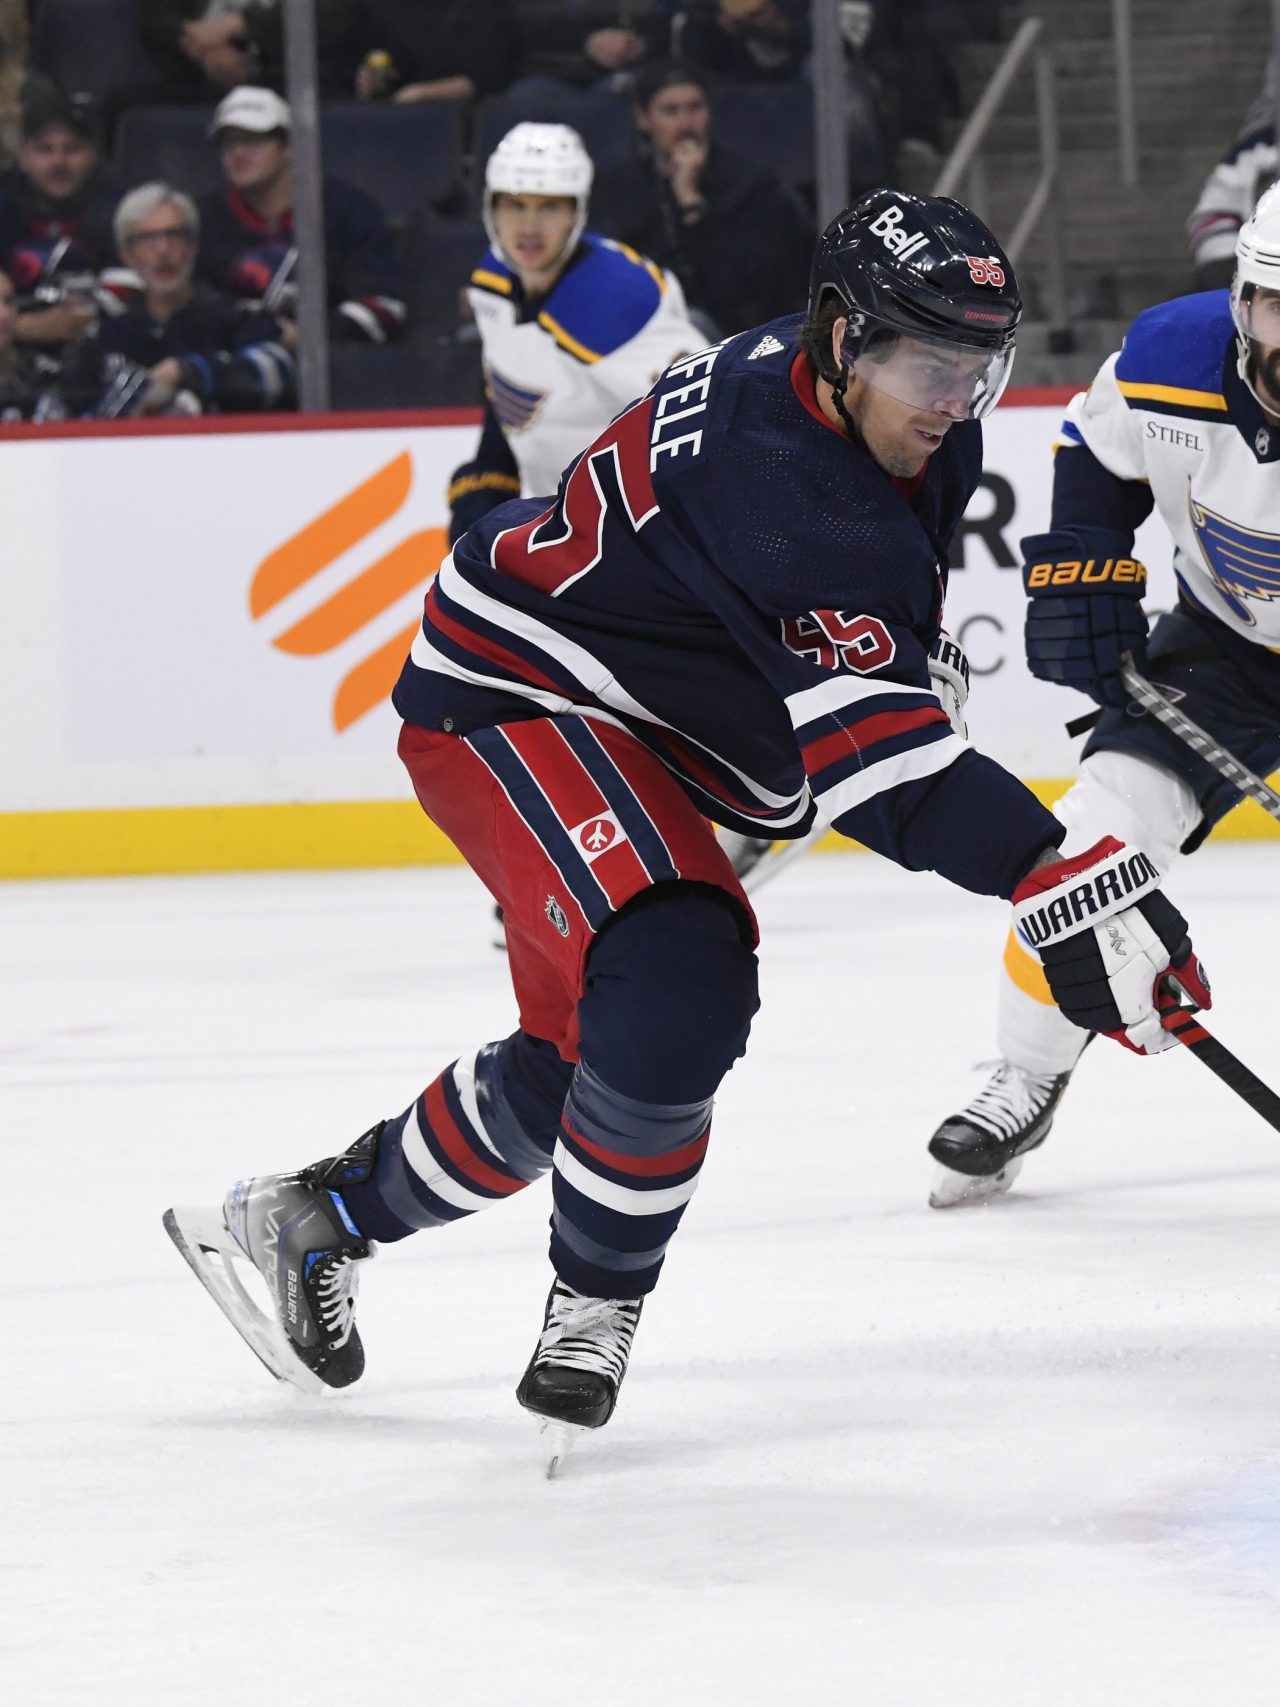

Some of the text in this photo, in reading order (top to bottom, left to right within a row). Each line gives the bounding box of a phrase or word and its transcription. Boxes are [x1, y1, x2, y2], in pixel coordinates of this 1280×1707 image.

[868, 205, 931, 262] Bell
[967, 256, 1005, 287] 55
[650, 331, 748, 474] IFELE
[1146, 421, 1204, 452] STIFEL
[779, 608, 897, 675] 55
